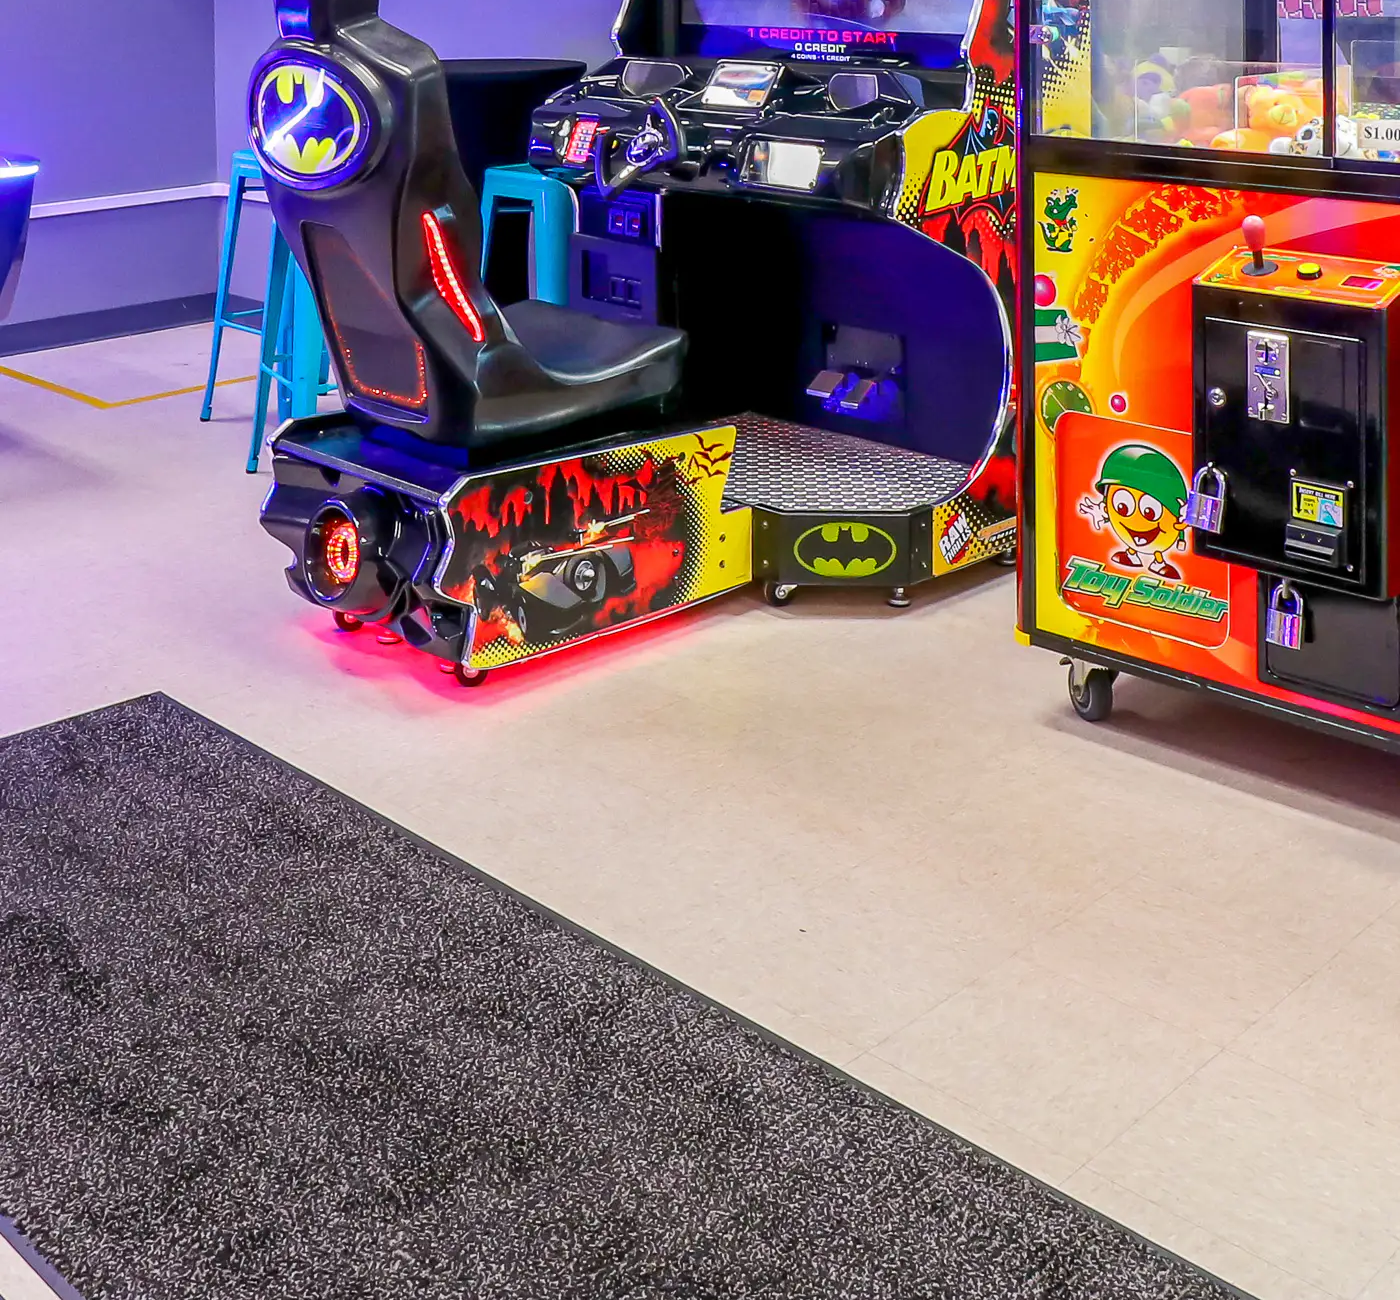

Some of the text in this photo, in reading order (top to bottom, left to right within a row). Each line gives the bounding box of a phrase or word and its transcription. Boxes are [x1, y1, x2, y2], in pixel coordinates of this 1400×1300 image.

[747, 28, 898, 44] 1 CREDIT TO START
[804, 43, 847, 53] CREDIT
[939, 511, 968, 557] RAW
[1063, 556, 1228, 621] Toy Soldier
